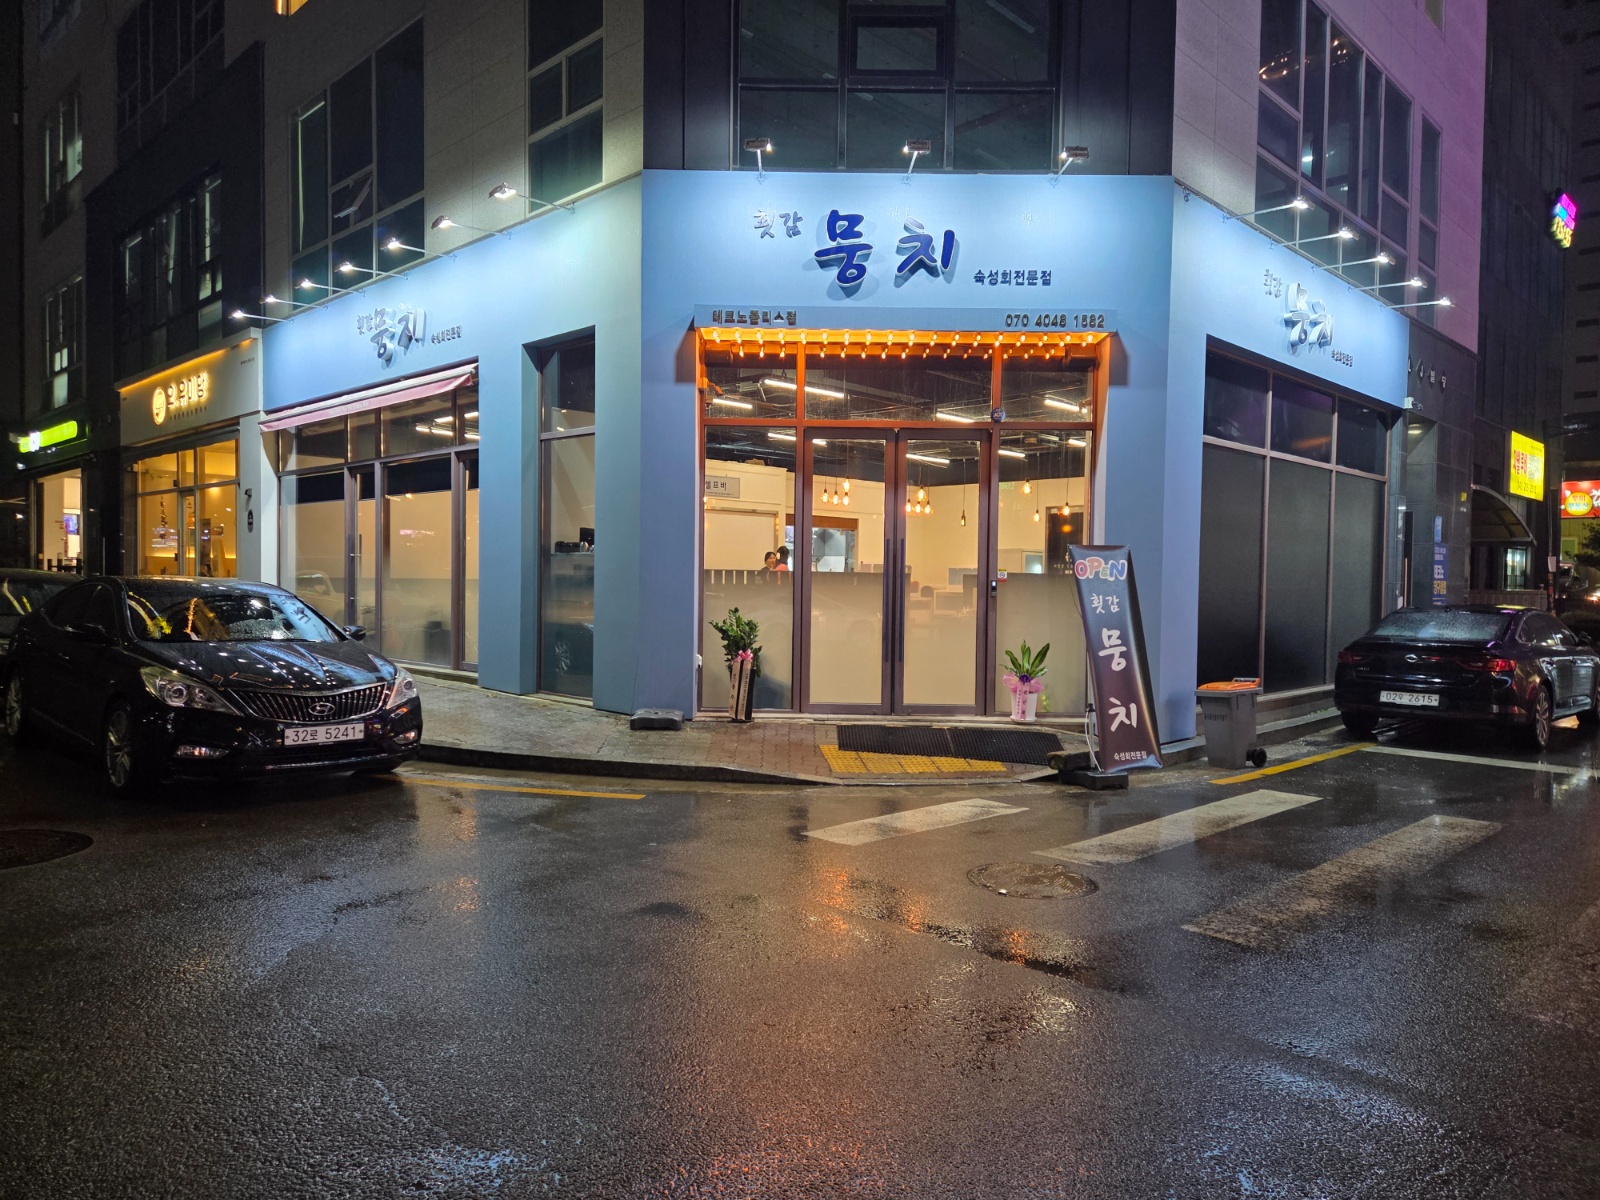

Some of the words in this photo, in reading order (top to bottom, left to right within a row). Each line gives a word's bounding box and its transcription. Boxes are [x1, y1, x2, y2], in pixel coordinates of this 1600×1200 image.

[753, 208, 803, 239] 횟감
[973, 269, 1052, 286] 숙성회전문점
[712, 309, 797, 326] 테크노폴리스점
[1005, 313, 1030, 328] 070
[1035, 313, 1067, 328] 4048
[1074, 313, 1105, 328] 1582
[1074, 557, 1128, 581] OPEN
[1090, 593, 1120, 614] 횟감
[1408, 693, 1433, 704] 2615
[292, 729, 318, 743] 32로
[325, 725, 356, 740] 5241
